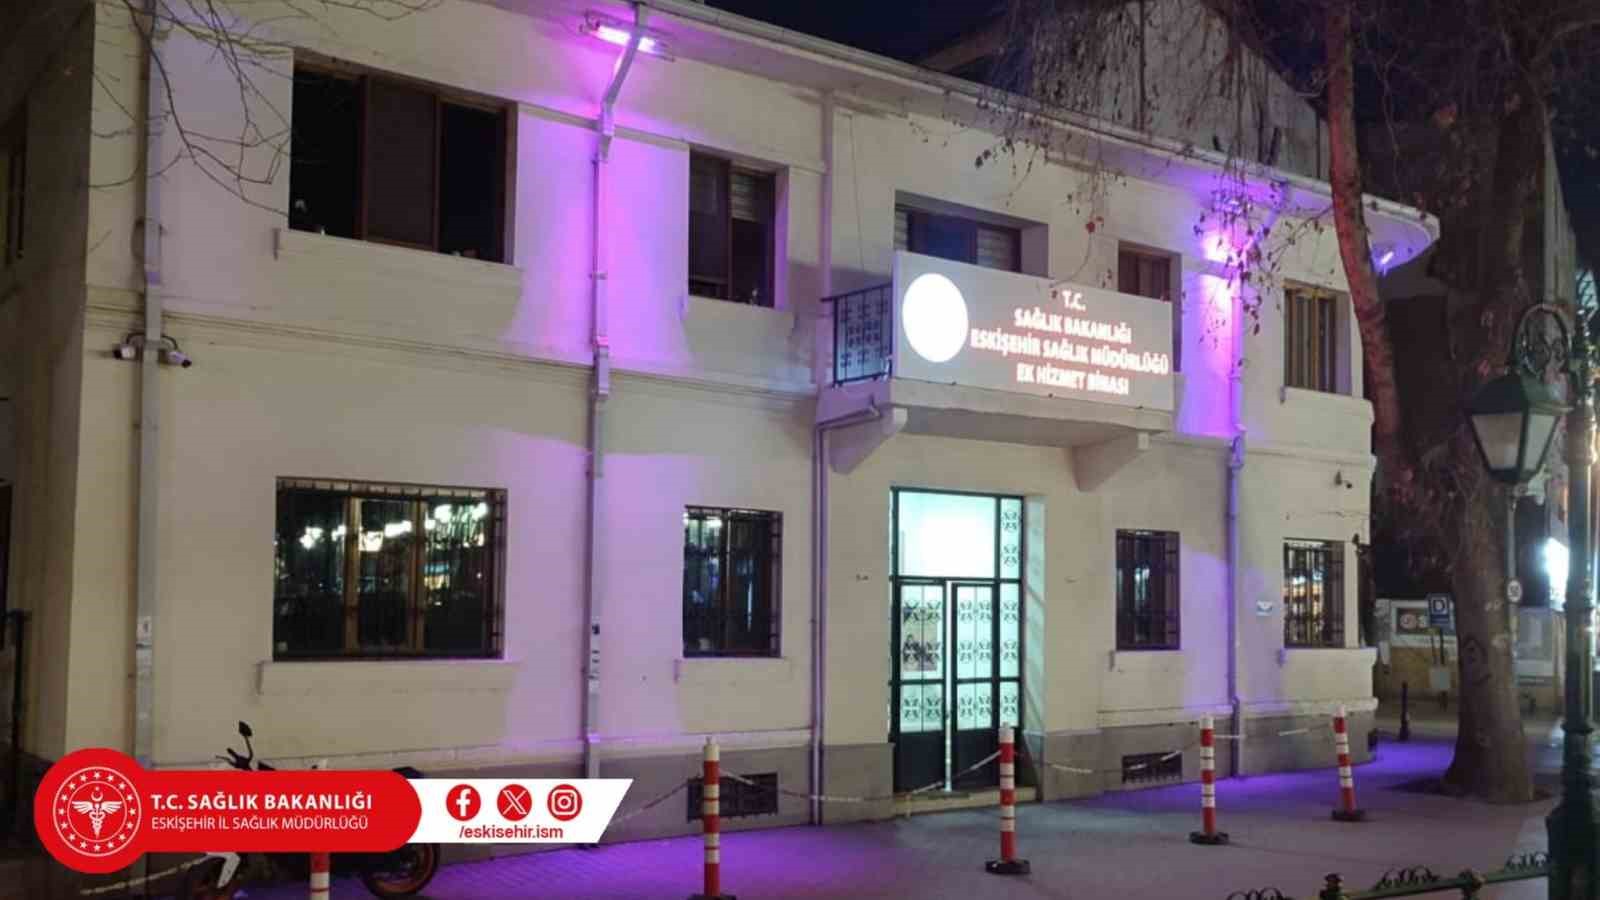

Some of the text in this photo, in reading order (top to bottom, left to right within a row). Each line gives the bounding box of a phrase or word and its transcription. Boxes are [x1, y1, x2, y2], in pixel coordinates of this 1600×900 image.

[1062, 290, 1087, 311] T.C.
[1014, 306, 1132, 344] SAĞLIK BAKANLIĞI
[970, 327, 1169, 375] ESKİŞEHİR SAĞLIK MÜDÜRLÜĞÜ
[1016, 362, 1129, 395] EK HİZMET BİNASI
